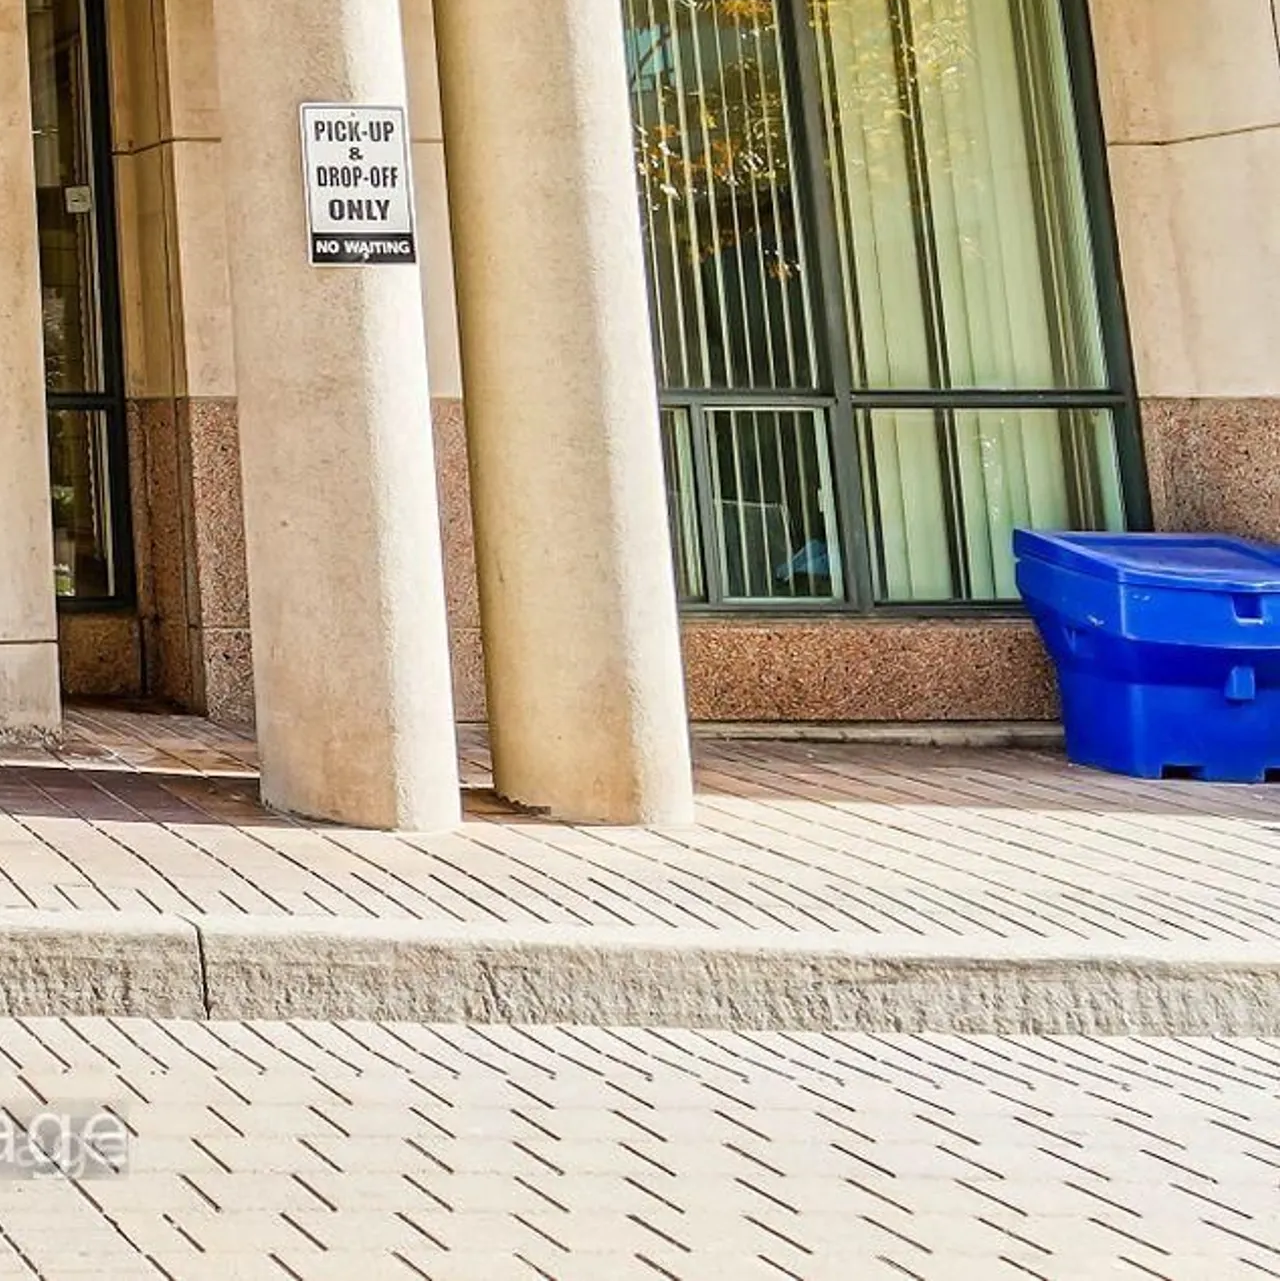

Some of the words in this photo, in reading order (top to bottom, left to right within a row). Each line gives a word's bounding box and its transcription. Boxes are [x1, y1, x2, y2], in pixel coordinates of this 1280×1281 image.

[314, 121, 395, 142] PICK-UP
[348, 147, 364, 160] &
[316, 166, 399, 188] DROP-OFF
[328, 199, 391, 221] ONLY
[315, 240, 340, 254] NO
[343, 241, 410, 254] WAITING
